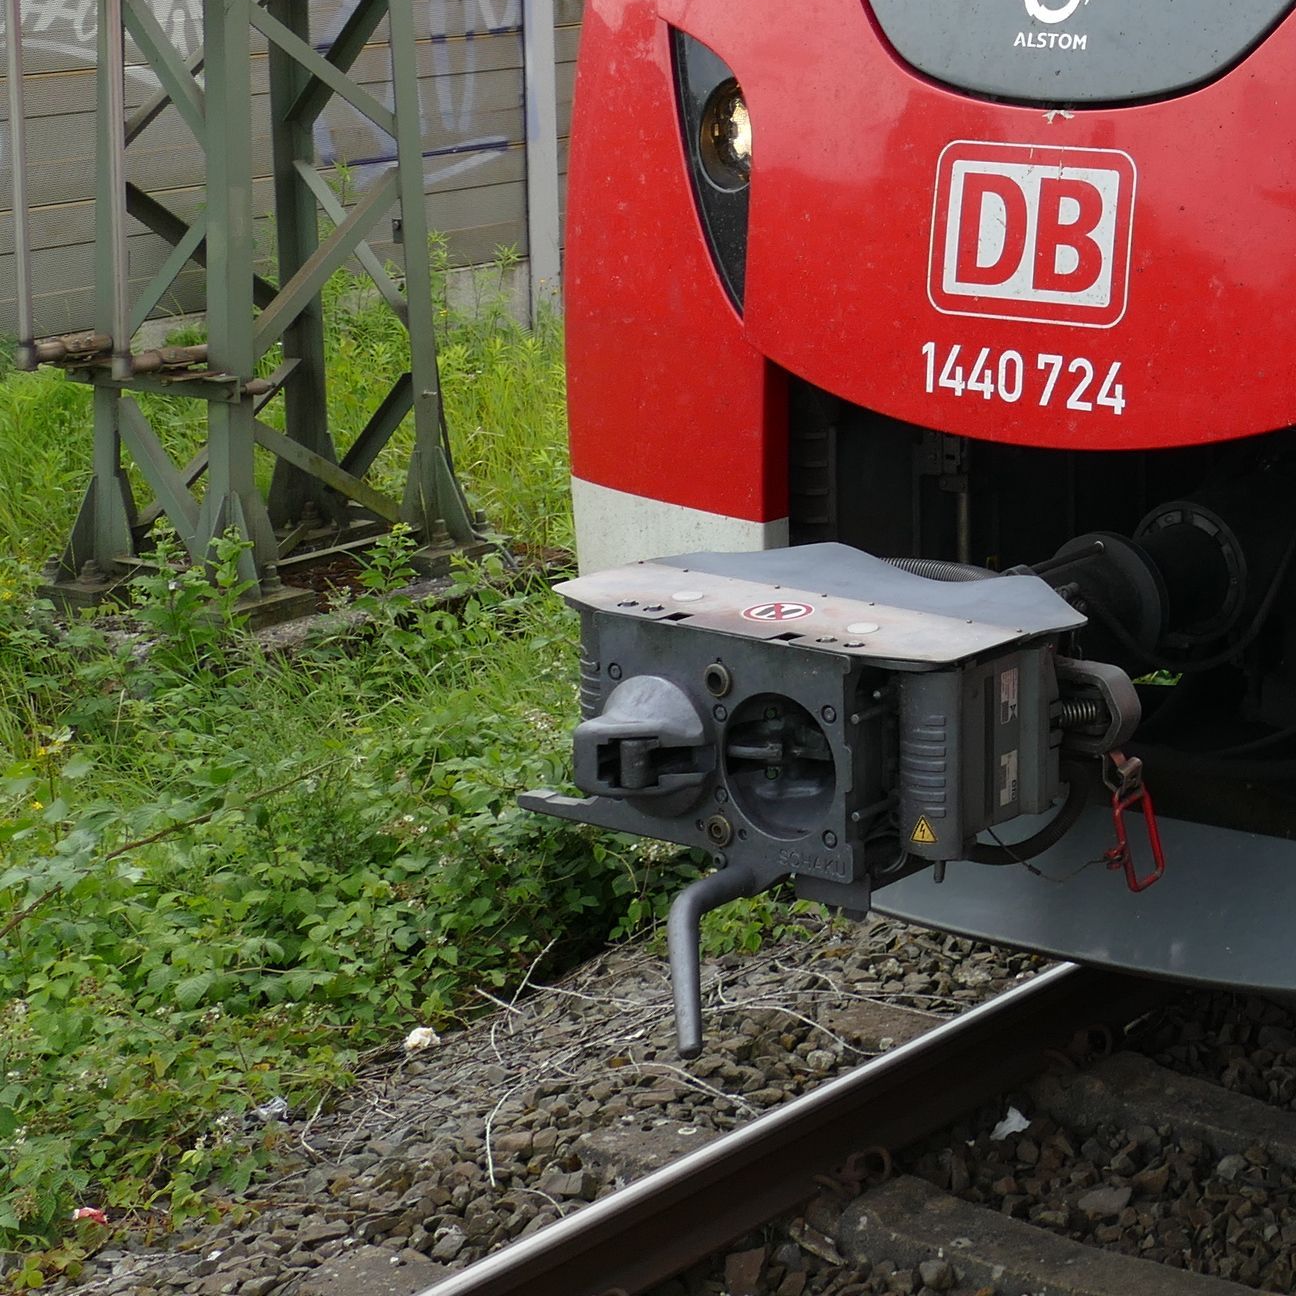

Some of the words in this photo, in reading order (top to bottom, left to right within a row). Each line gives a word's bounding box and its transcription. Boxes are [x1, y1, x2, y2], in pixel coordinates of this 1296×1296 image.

[1013, 31, 1088, 51] ALSTOM
[954, 171, 1104, 295] DB
[921, 341, 1024, 404] 1440
[1036, 353, 1126, 416] 724
